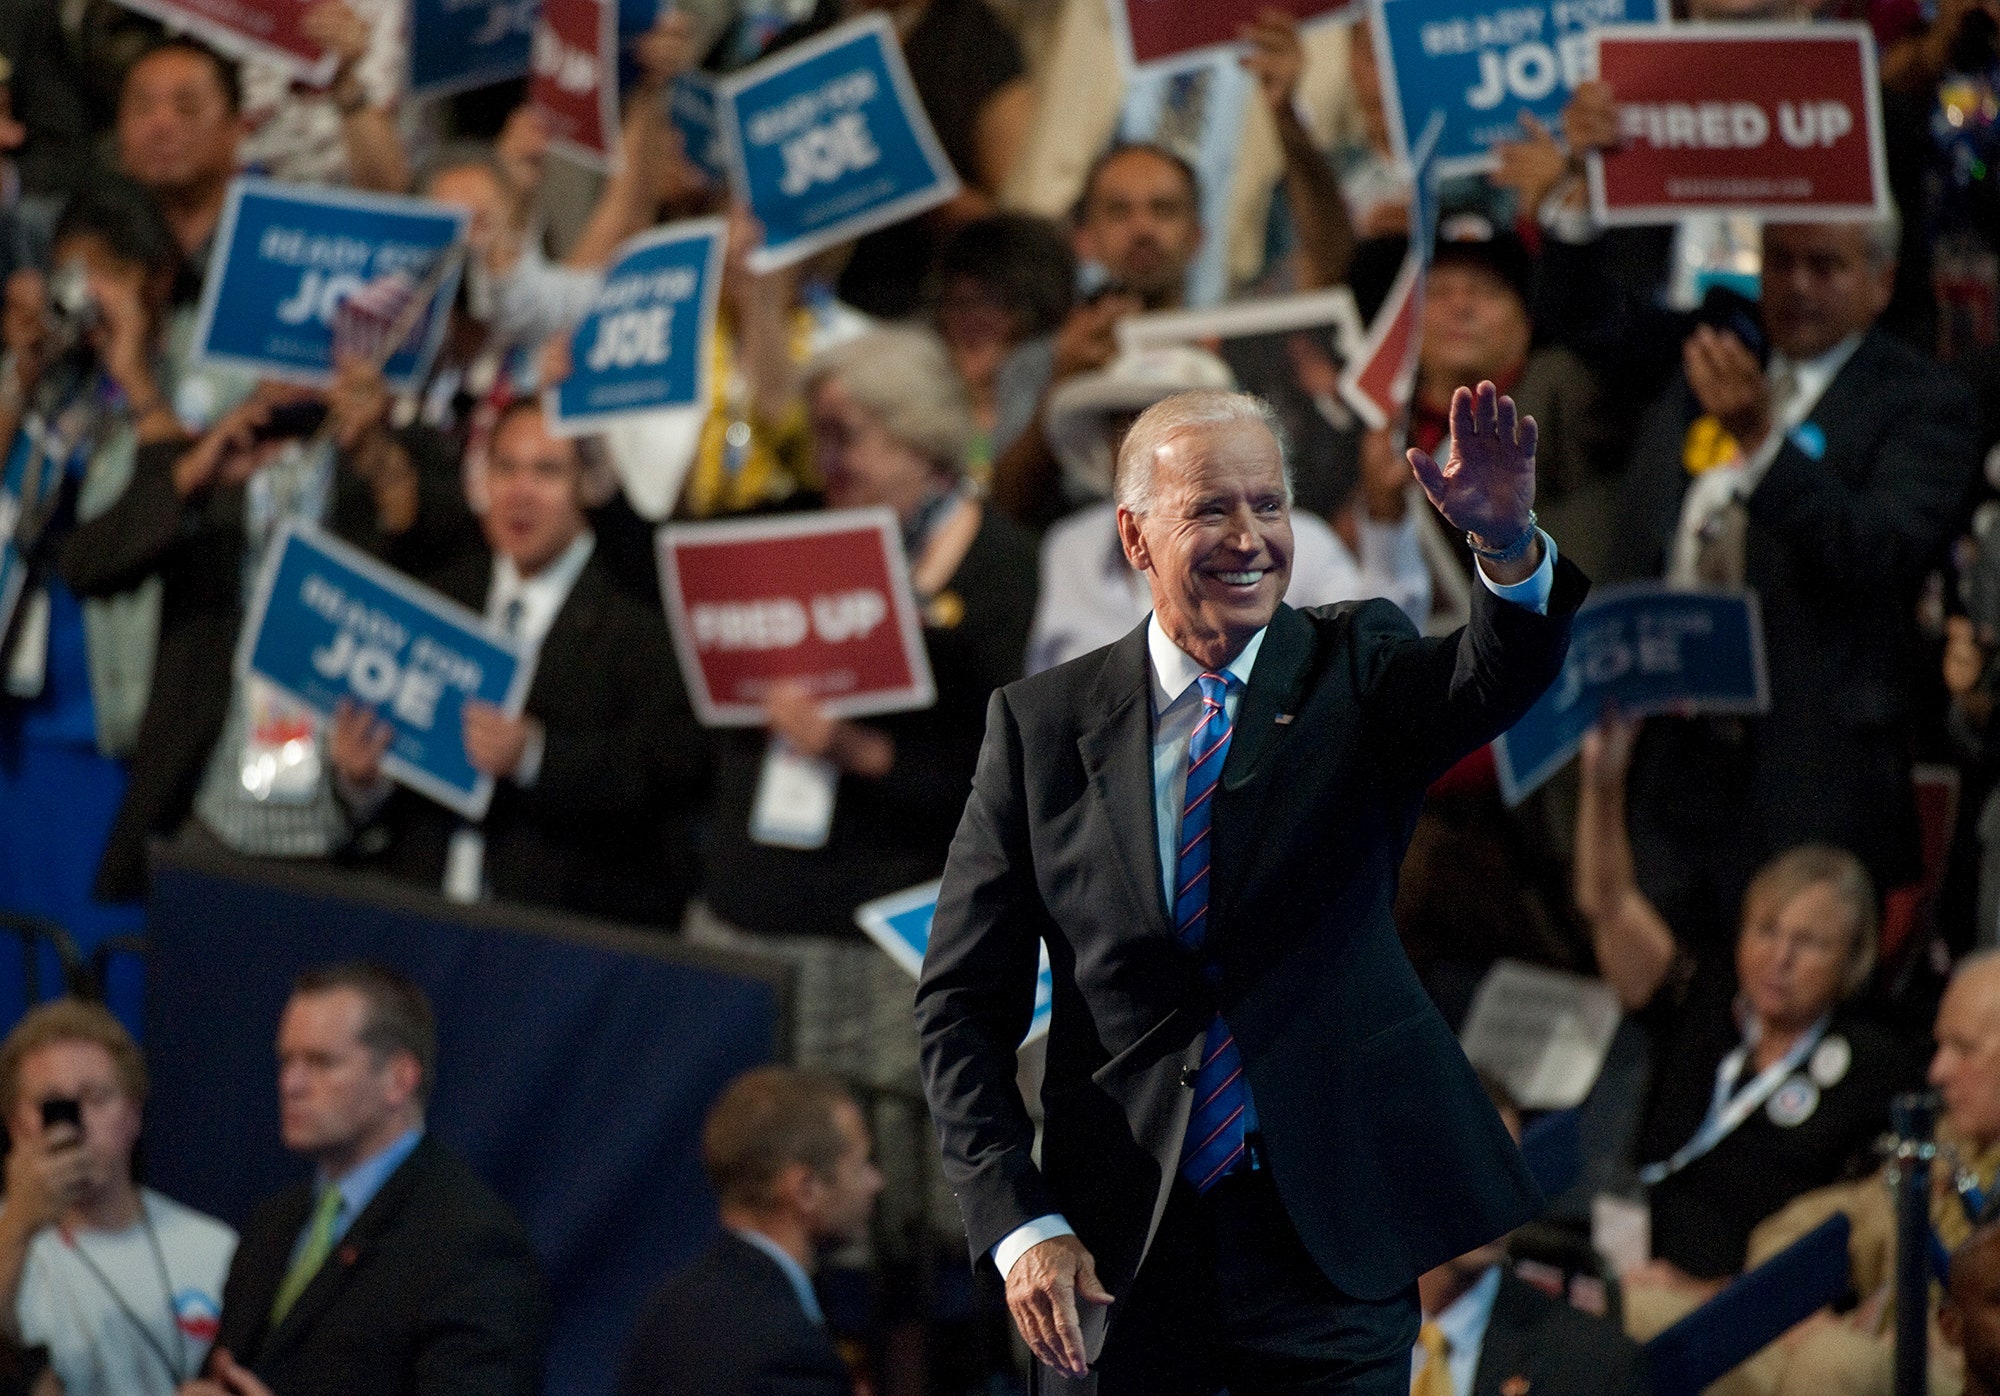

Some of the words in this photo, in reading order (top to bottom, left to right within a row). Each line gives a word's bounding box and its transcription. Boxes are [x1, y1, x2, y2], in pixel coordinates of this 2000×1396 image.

[1421, 9, 1545, 57] READY
[779, 110, 881, 196] JOE
[1779, 100, 1853, 149] UP
[586, 303, 674, 373] JOE
[300, 573, 409, 650] READY
[412, 634, 484, 693] FOR
[811, 587, 888, 644] UP
[311, 630, 445, 732] JOE
